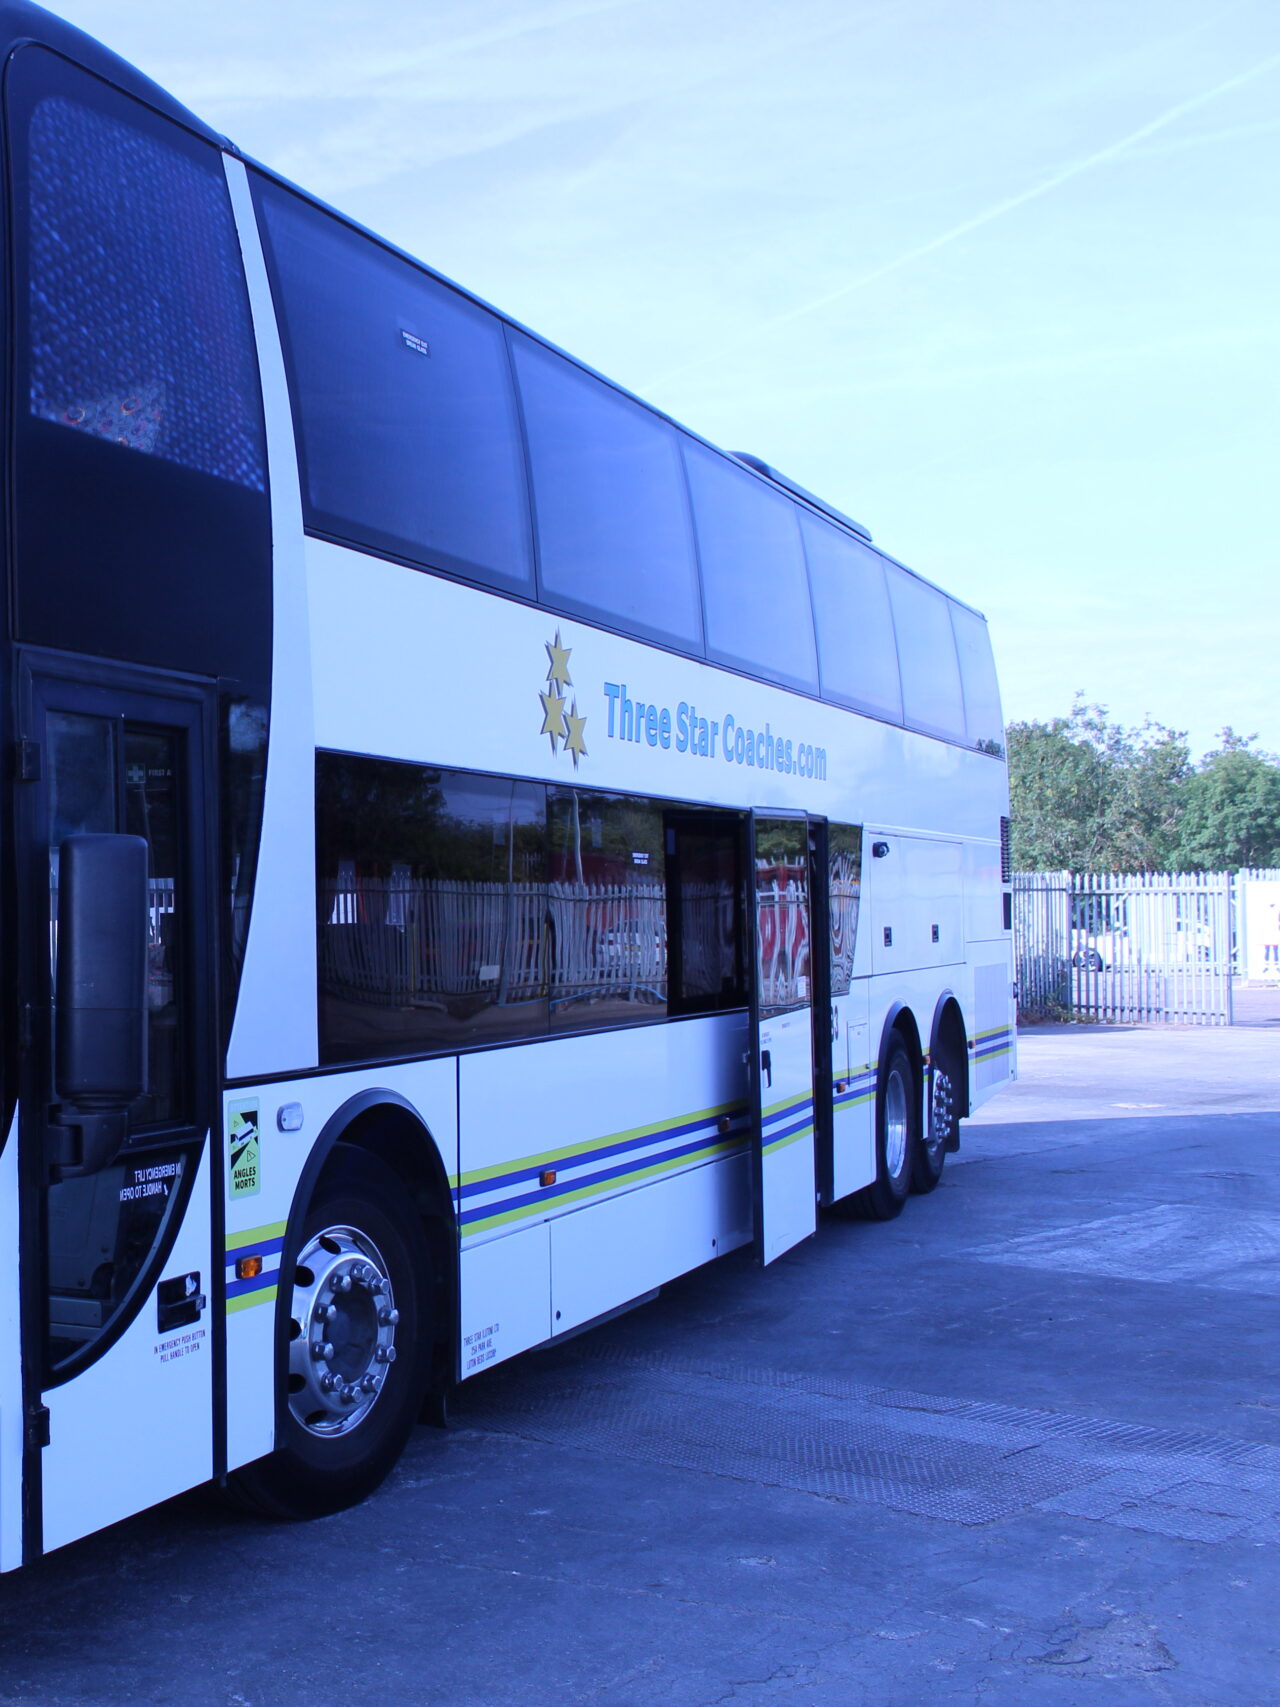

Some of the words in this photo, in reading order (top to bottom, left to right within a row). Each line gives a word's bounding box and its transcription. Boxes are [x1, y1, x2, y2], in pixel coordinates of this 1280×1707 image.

[603, 681, 671, 749] Three
[676, 701, 718, 758] Star
[722, 713, 827, 781] Coaches.com
[233, 1166, 256, 1179] ANGLES
[234, 1177, 256, 1190] MORTS
